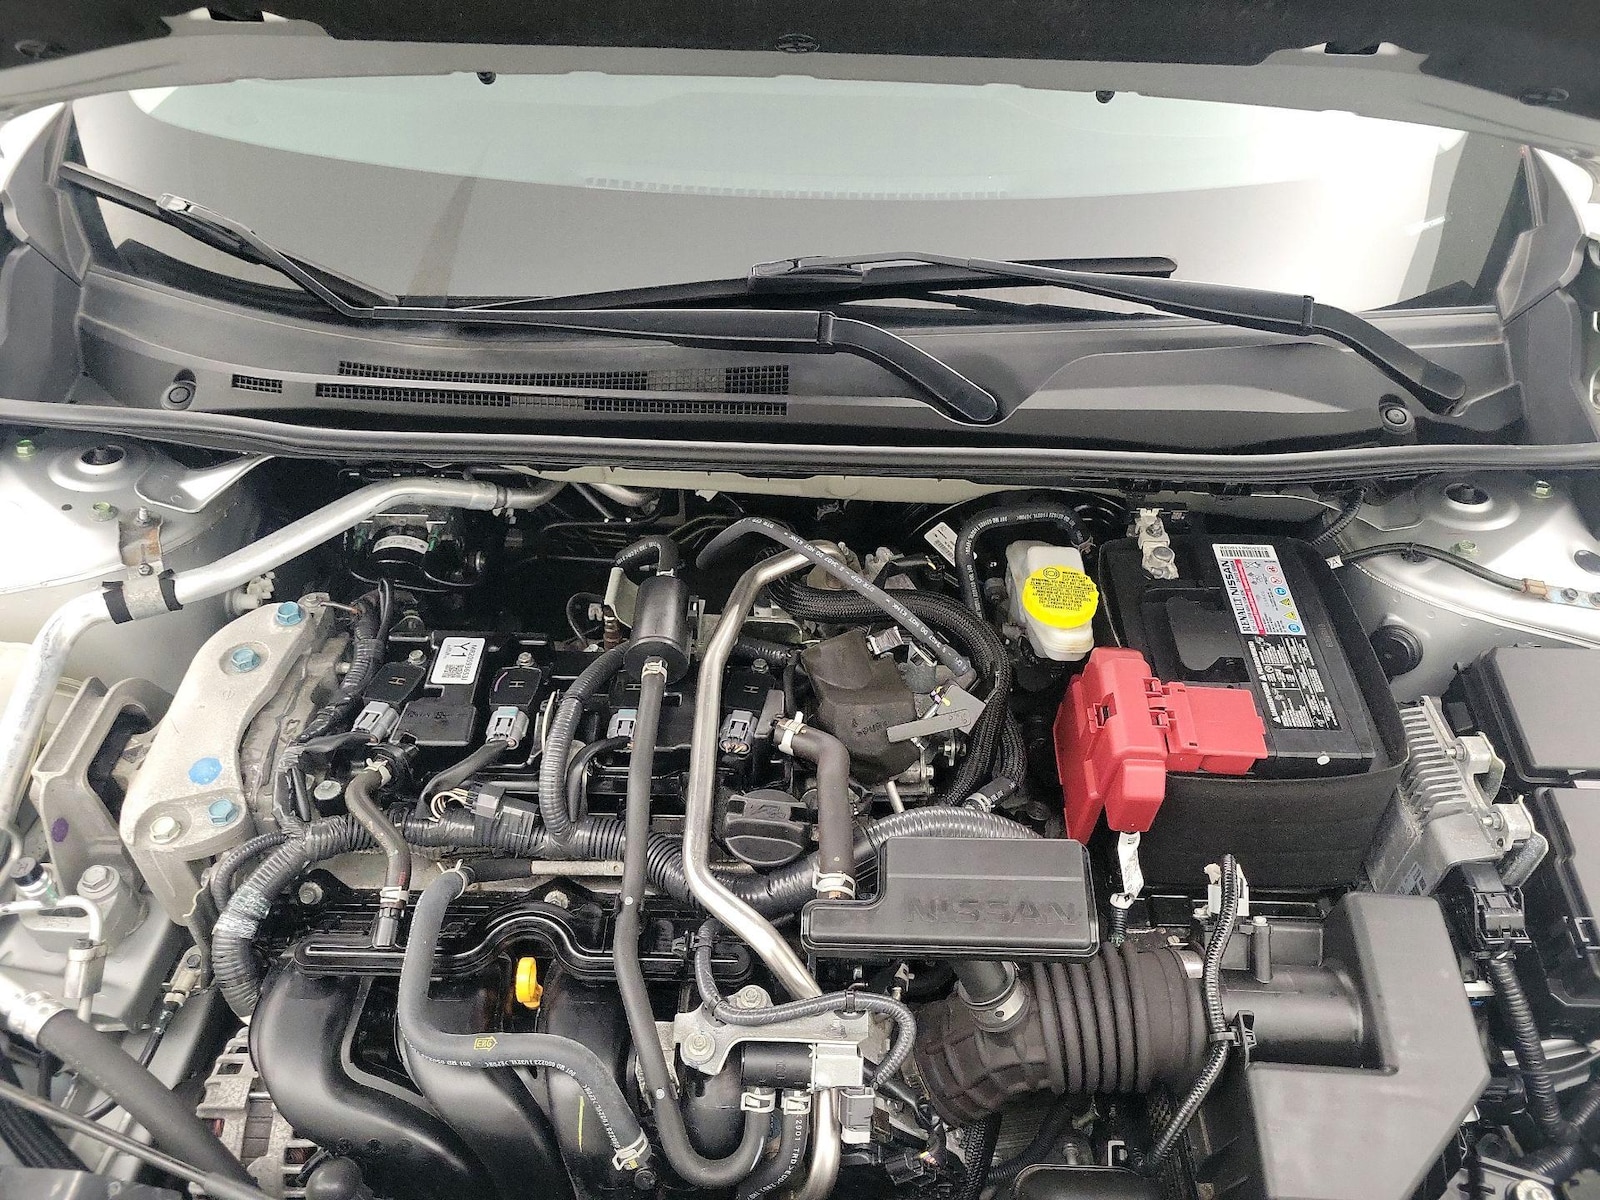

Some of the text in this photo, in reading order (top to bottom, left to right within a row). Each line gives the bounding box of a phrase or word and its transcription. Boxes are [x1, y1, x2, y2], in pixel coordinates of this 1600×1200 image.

[804, 543, 815, 553] NOT
[1221, 560, 1252, 633] RENAULT NISSAN
[907, 616, 919, 628] NOT
[451, 642, 471, 657] Y1
[907, 895, 1076, 926] NISSAN
